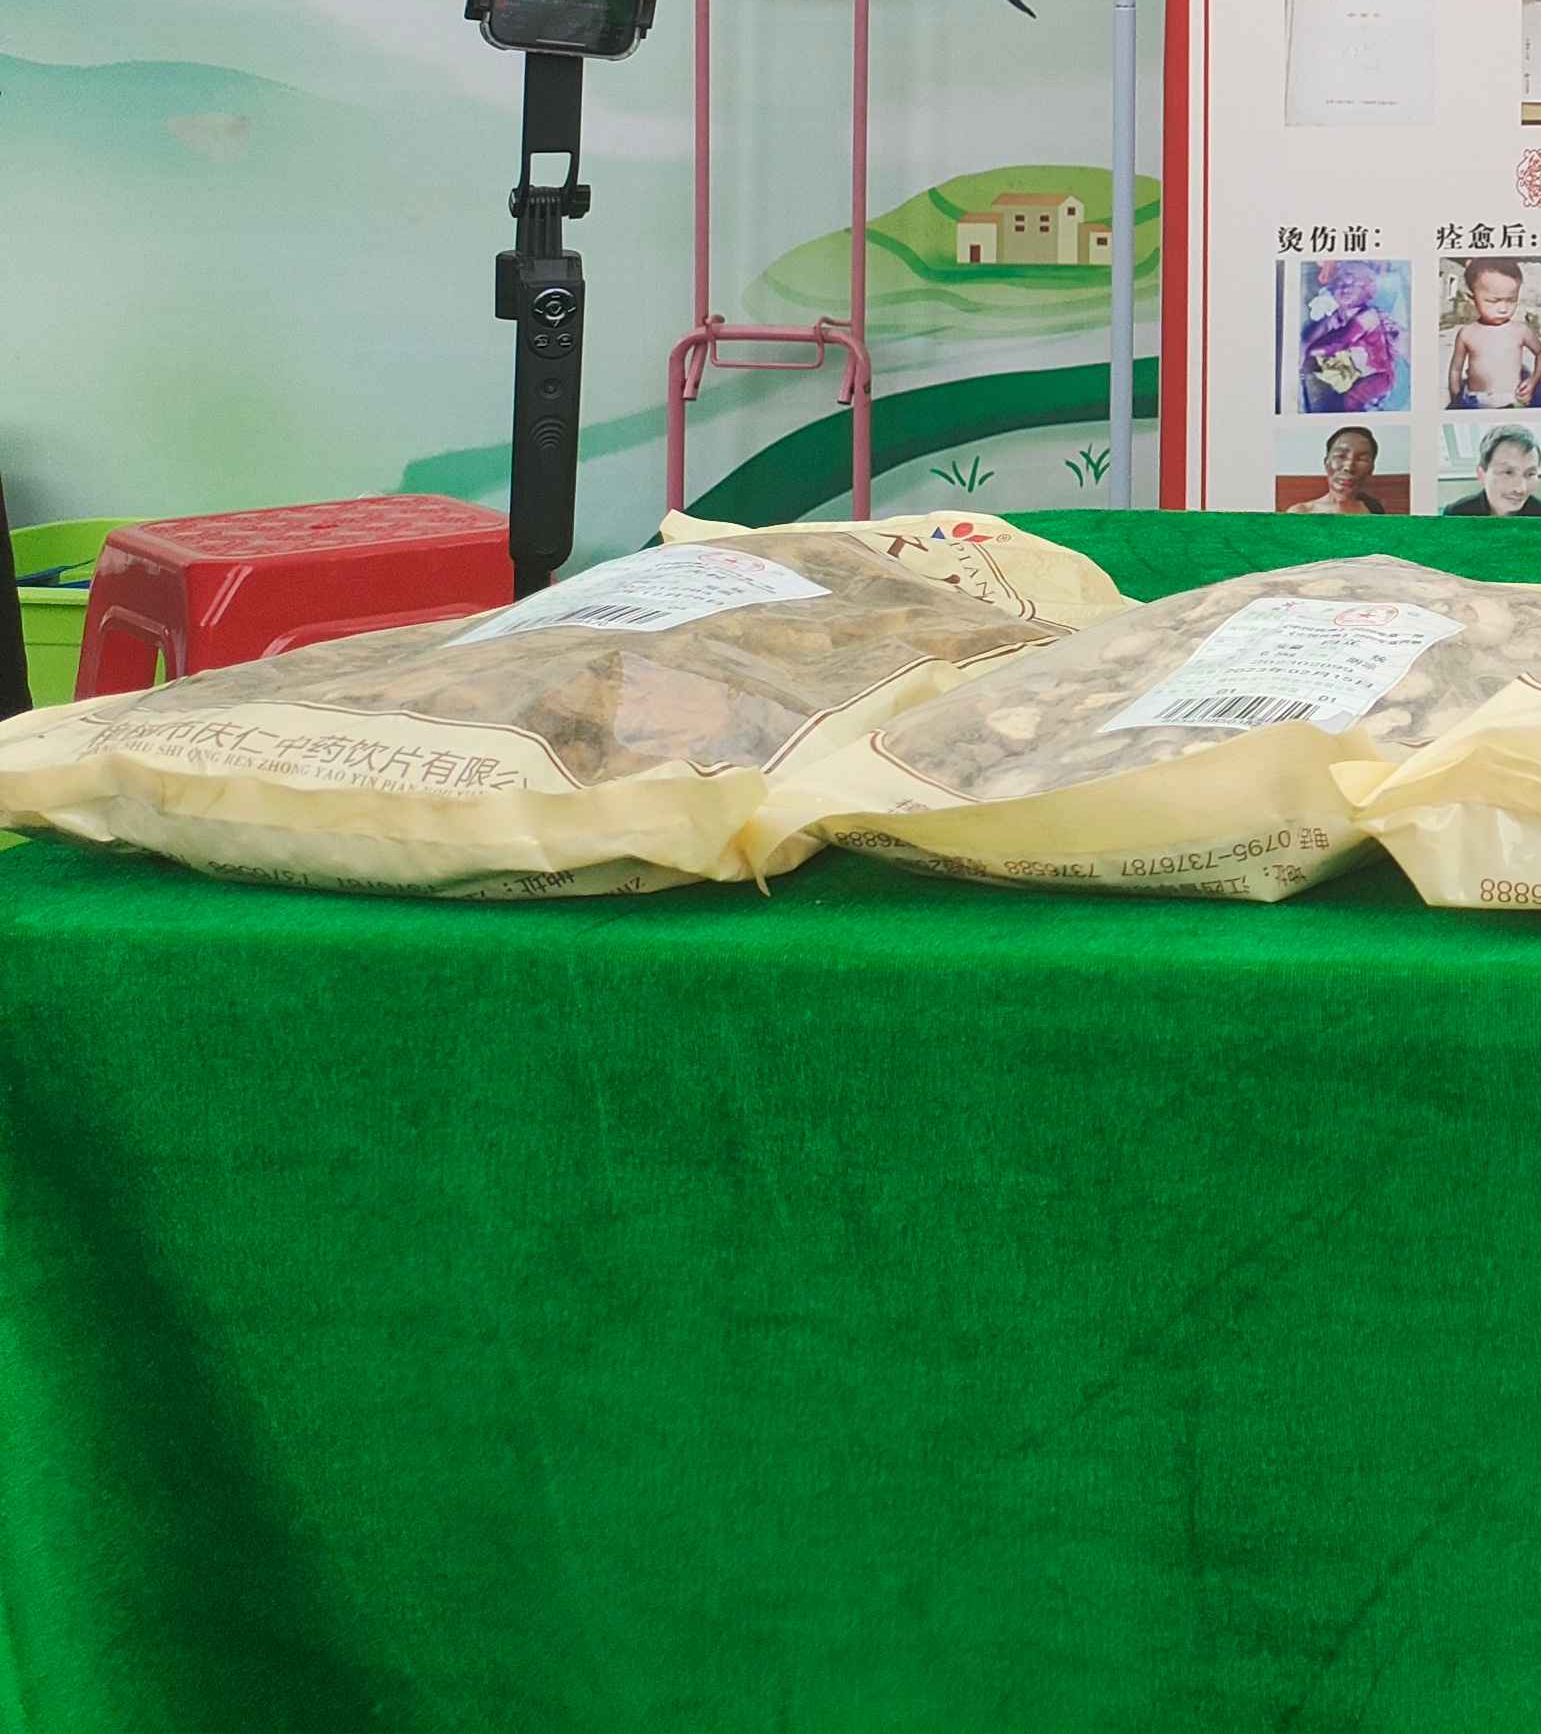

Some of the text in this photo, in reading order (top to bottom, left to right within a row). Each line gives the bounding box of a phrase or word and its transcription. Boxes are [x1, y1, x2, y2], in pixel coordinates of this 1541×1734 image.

[1276, 222, 1384, 255] 烫伤前：
[1435, 221, 1541, 251] 痊愈后：
[313, 766, 347, 785] YAO
[1004, 858, 1103, 880] 7376588
